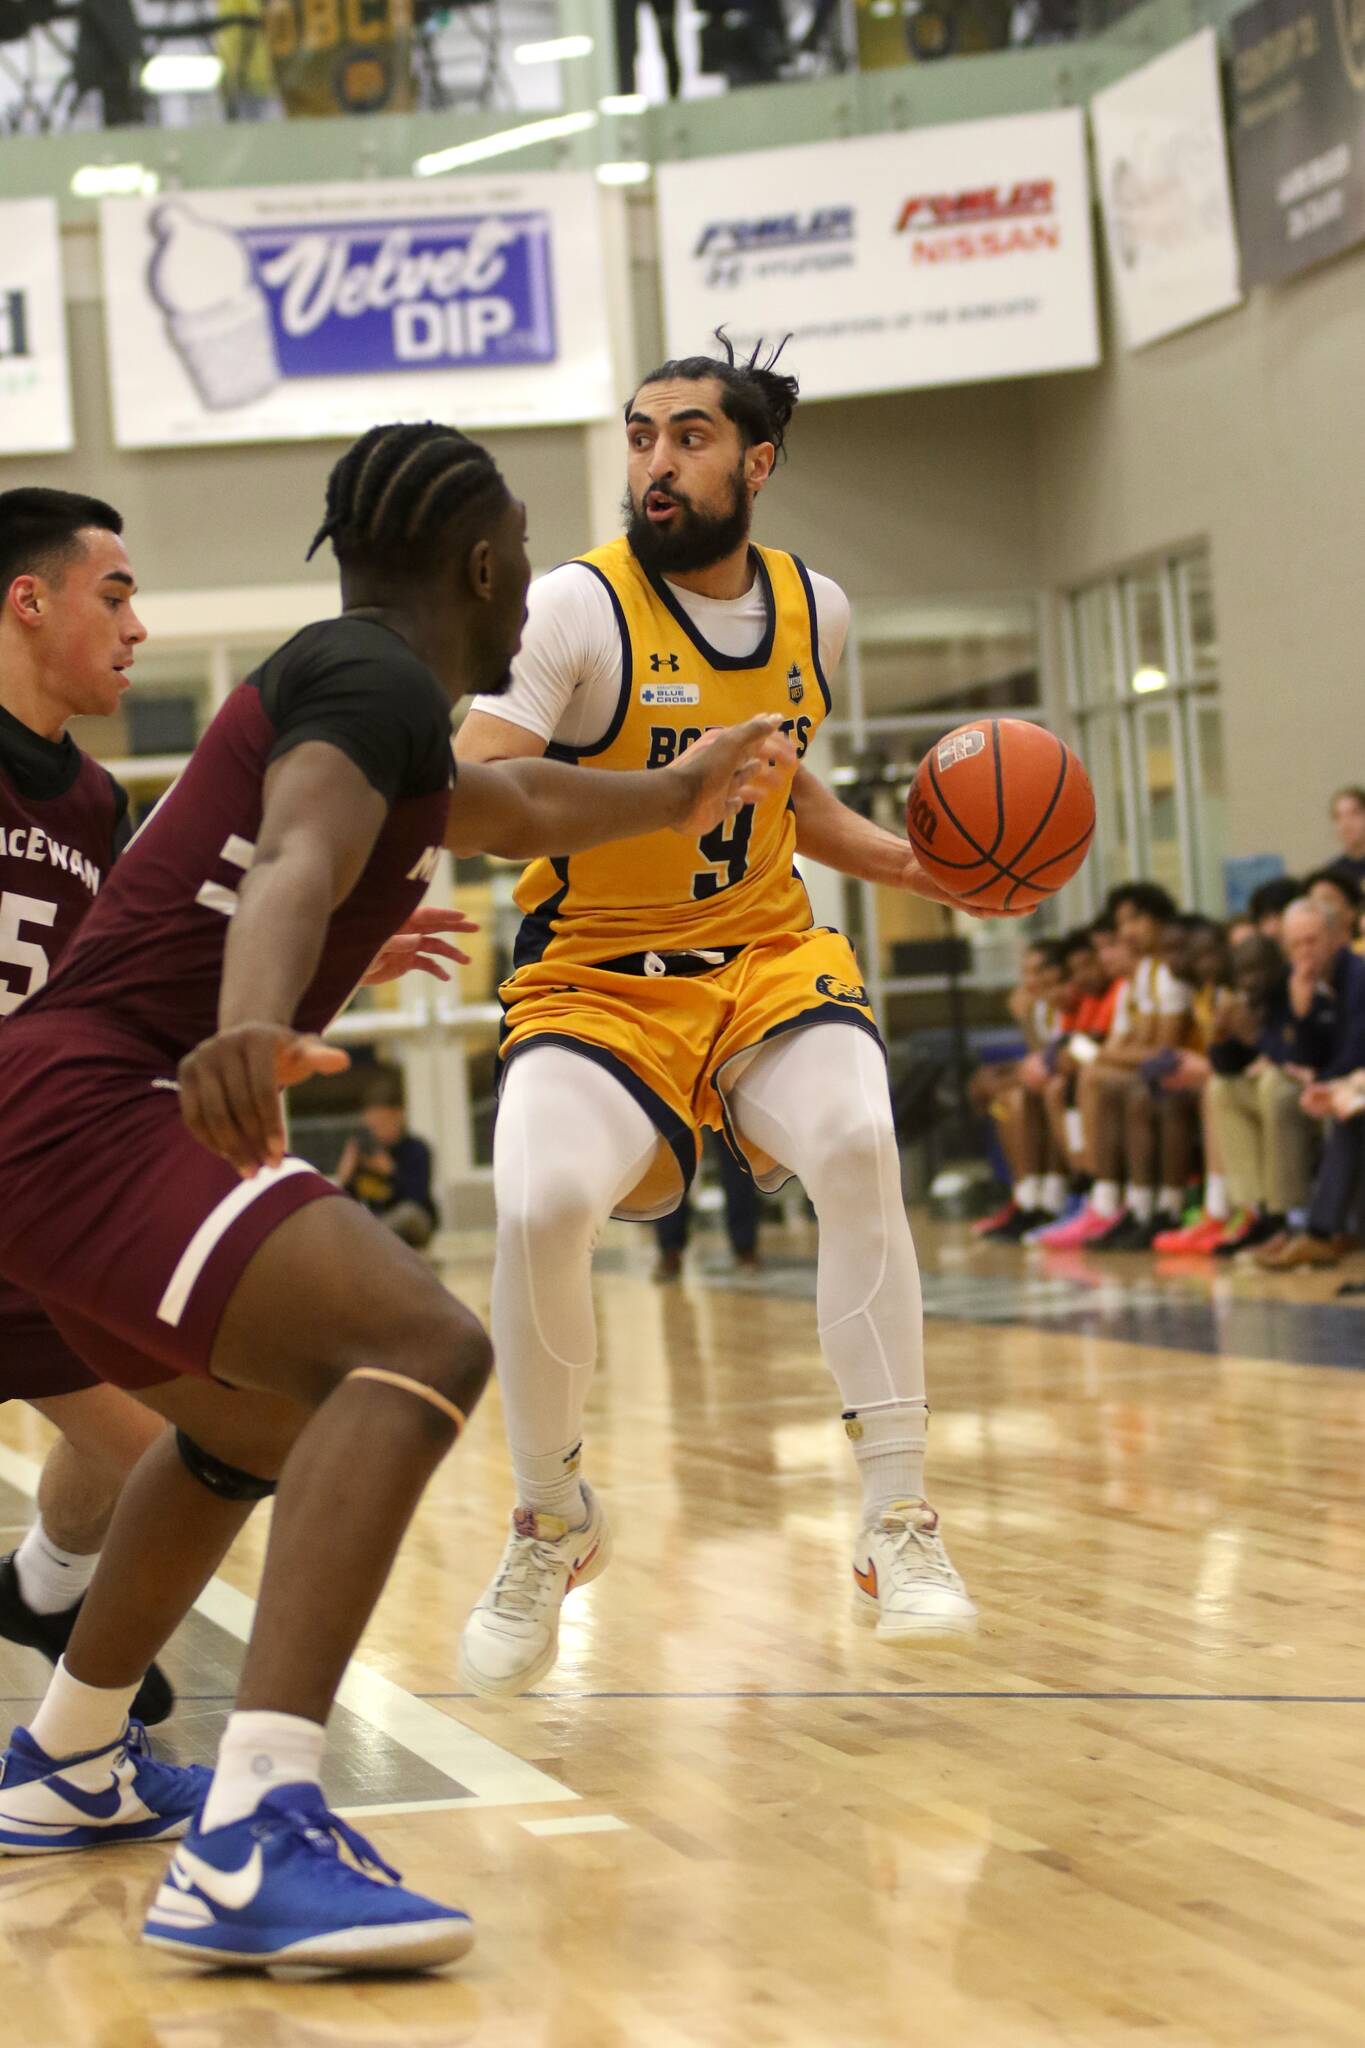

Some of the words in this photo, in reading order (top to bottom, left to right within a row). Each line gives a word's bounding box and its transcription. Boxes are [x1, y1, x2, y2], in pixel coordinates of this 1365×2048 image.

[913, 223, 1060, 266] NISSAN
[261, 219, 513, 337] Velvet
[393, 297, 515, 360] DIP
